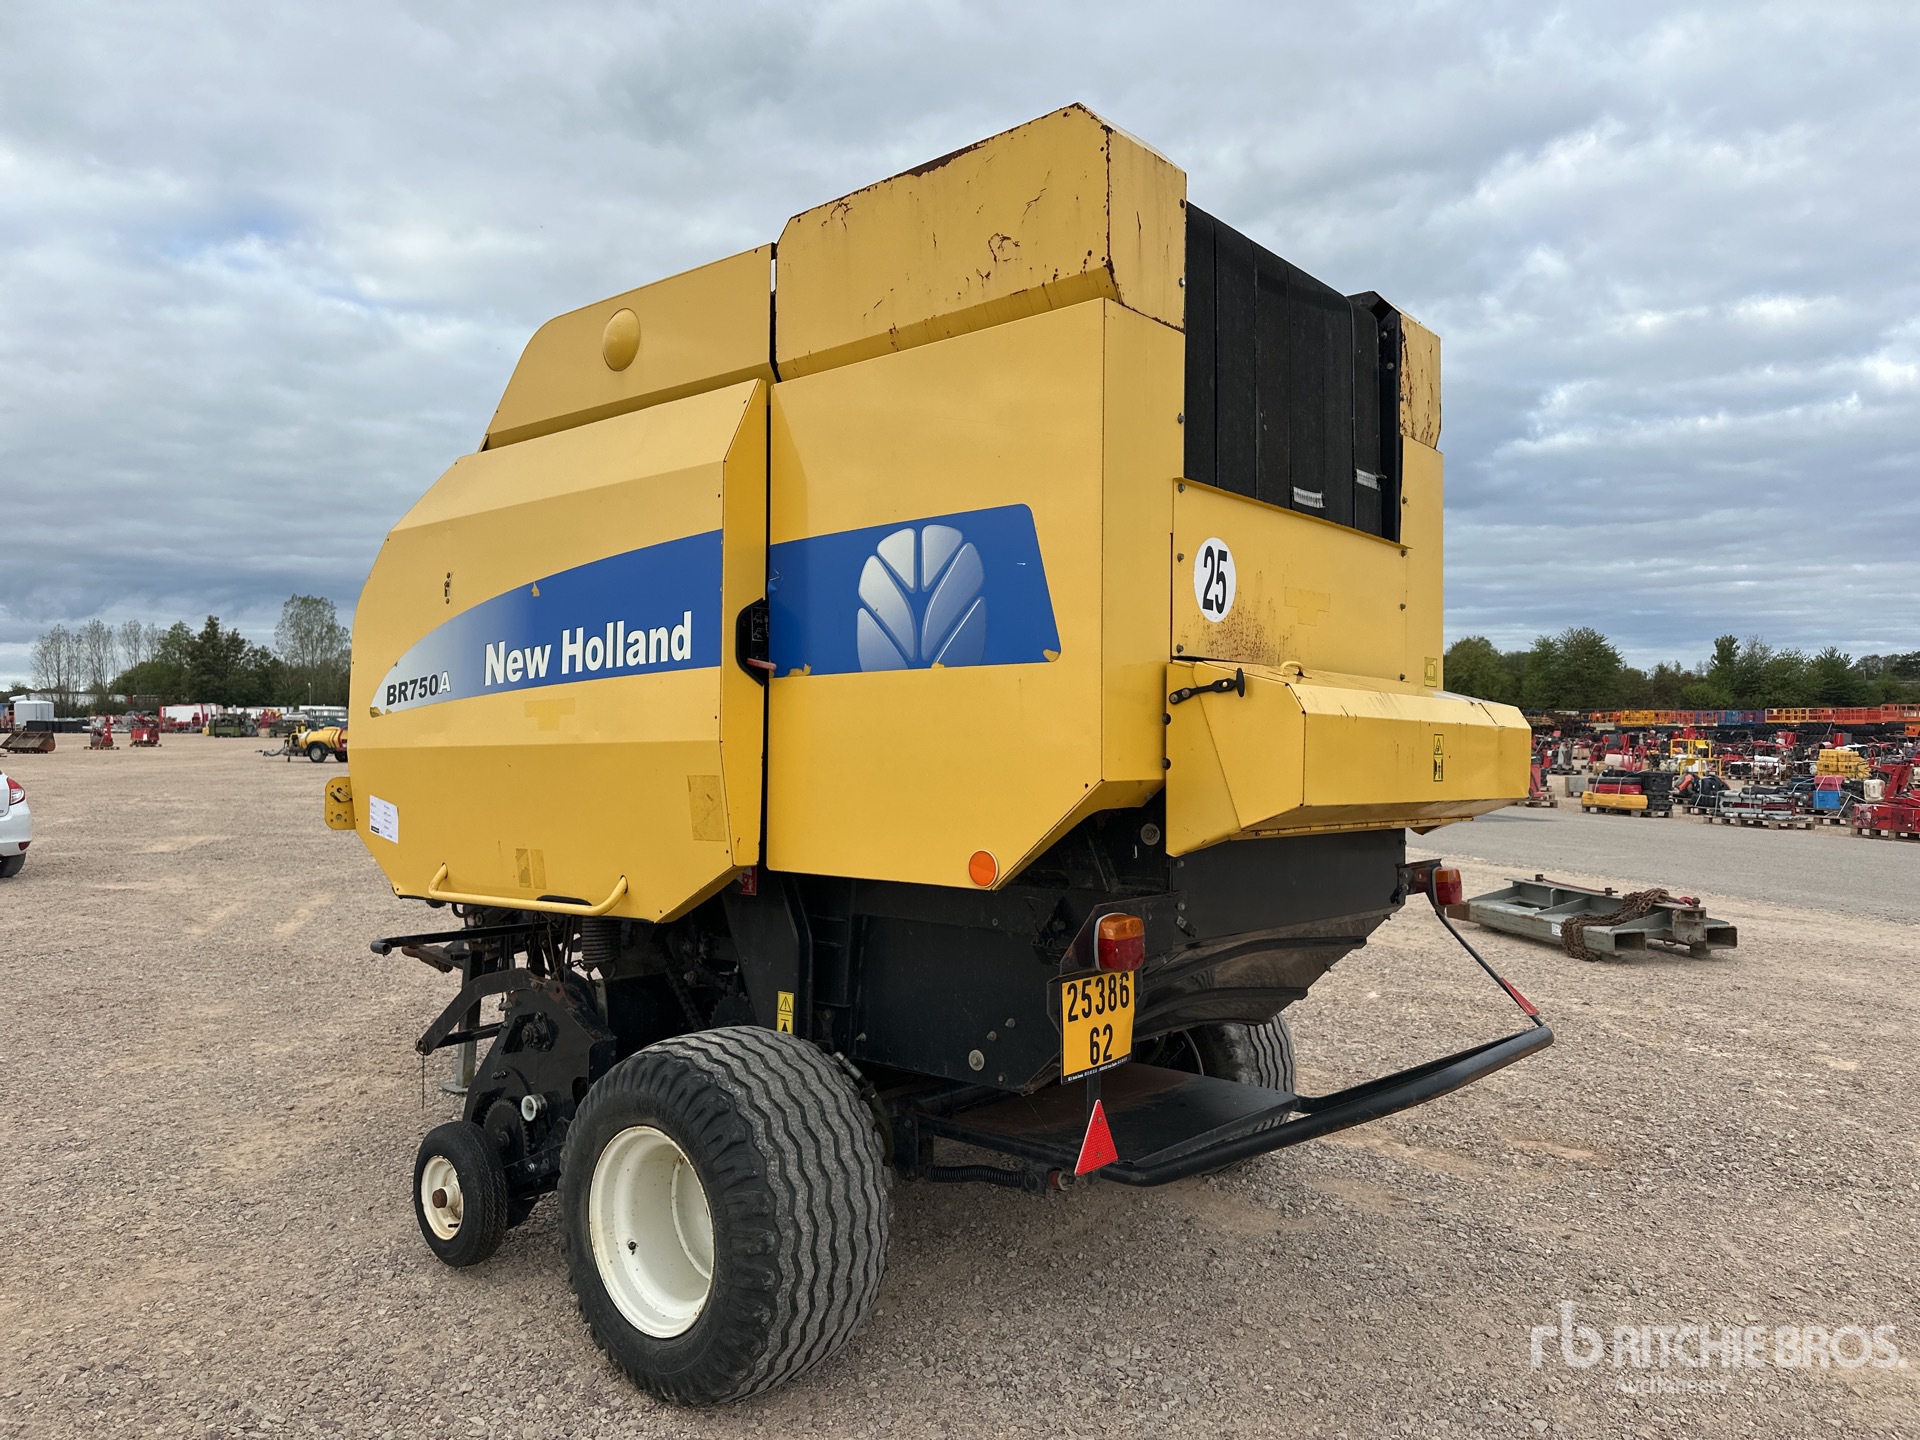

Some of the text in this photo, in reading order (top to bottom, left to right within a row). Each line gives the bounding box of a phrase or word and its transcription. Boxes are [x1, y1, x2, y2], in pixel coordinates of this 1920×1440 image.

[1202, 545, 1228, 614] 25
[484, 611, 692, 686] New Holland
[386, 671, 451, 707] BR750A
[1067, 972, 1130, 1023] 25386
[1089, 1023, 1113, 1066] 62
